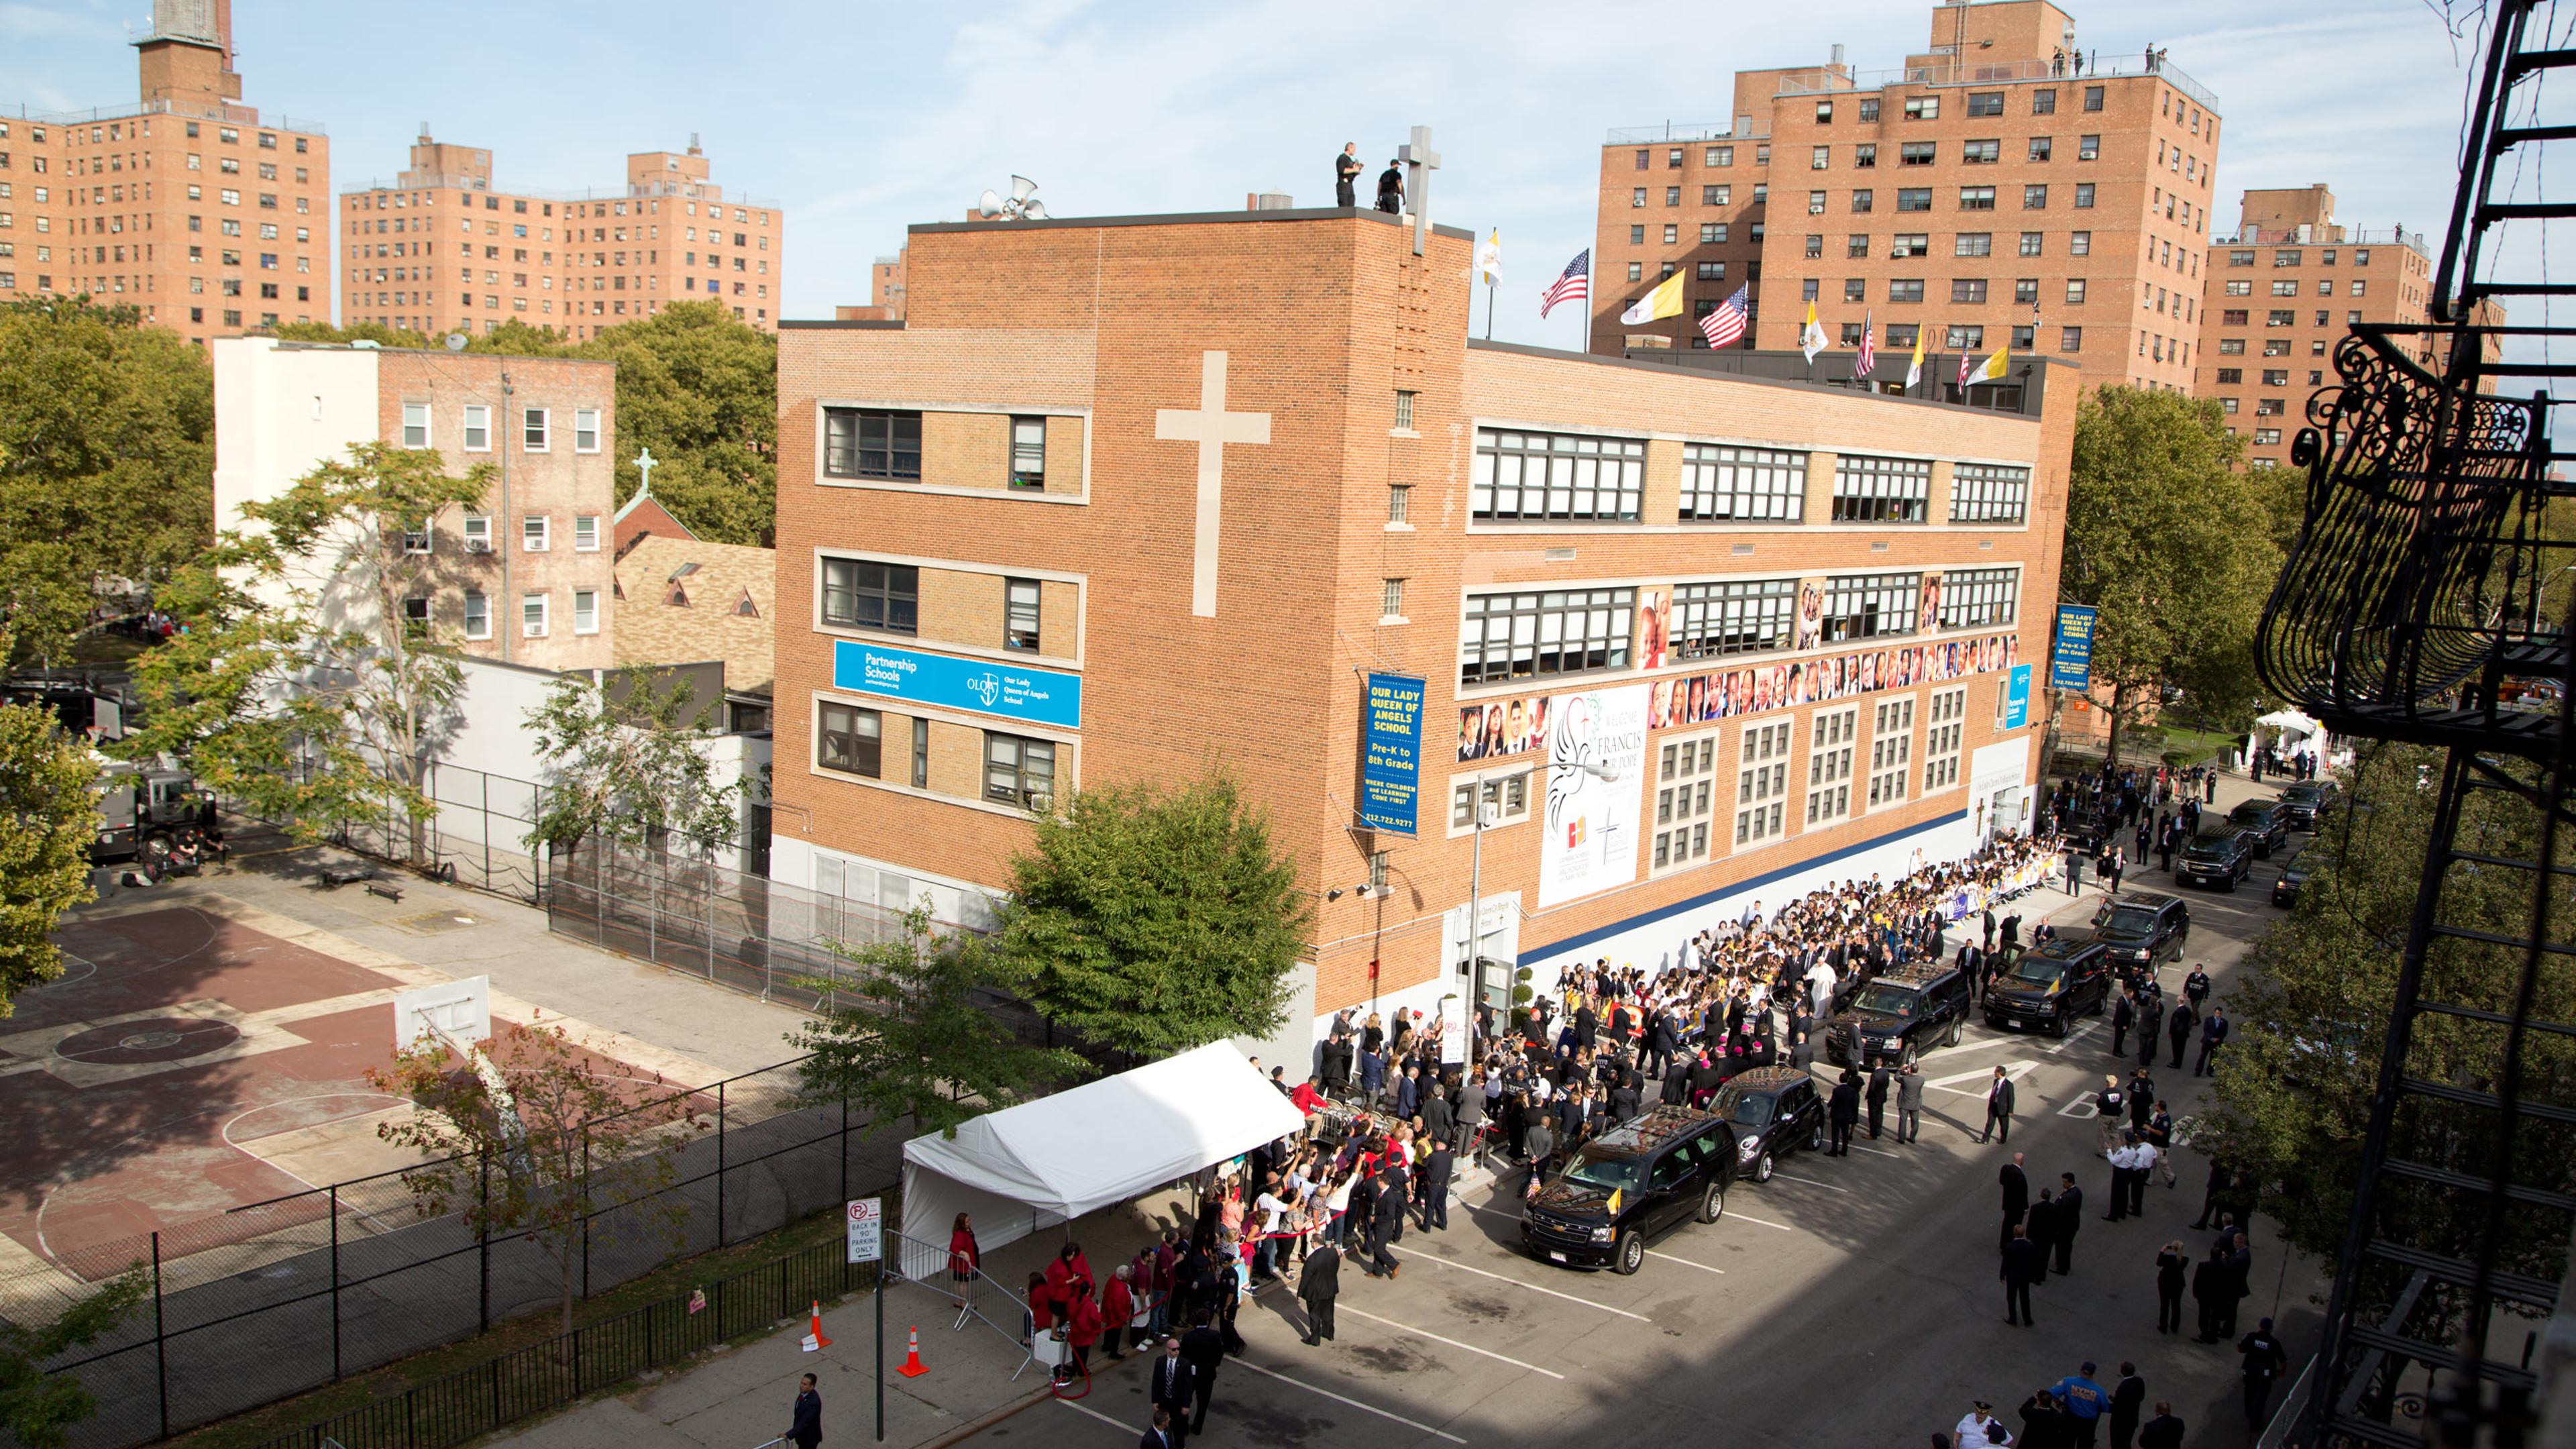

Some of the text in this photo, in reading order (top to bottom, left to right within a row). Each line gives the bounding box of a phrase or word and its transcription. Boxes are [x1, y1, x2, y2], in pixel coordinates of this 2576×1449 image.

[2063, 625, 2088, 633] ANGELS
[2063, 631, 2088, 639] SCHOOL
[865, 652, 917, 674] Partnership
[865, 665, 900, 682] Schools
[1004, 676, 1031, 688] Our Lady
[1004, 686, 1022, 695] Queen
[1030, 690, 1049, 700] Angels
[1004, 695, 1023, 706] School
[1371, 686, 1420, 702] OUR LADY
[1371, 697, 1419, 713] QUEEN OF
[1375, 709, 1413, 724] ANGELS
[1374, 720, 1412, 735] SCHOOL
[1372, 742, 1411, 757] Pre-K to
[1598, 731, 1642, 755] FRANCIS
[1368, 755, 1414, 771] 8th Grade
[1619, 754, 1637, 769] POPE
[1365, 779, 1416, 793] WHERE CHILDREN
[1380, 788, 1410, 799] LEARNING
[1371, 794, 1407, 805] COME FIRST
[1366, 813, 1413, 828] 212.722.9277
[851, 1222, 868, 1230] BACK
[851, 1237, 877, 1246] PARKING
